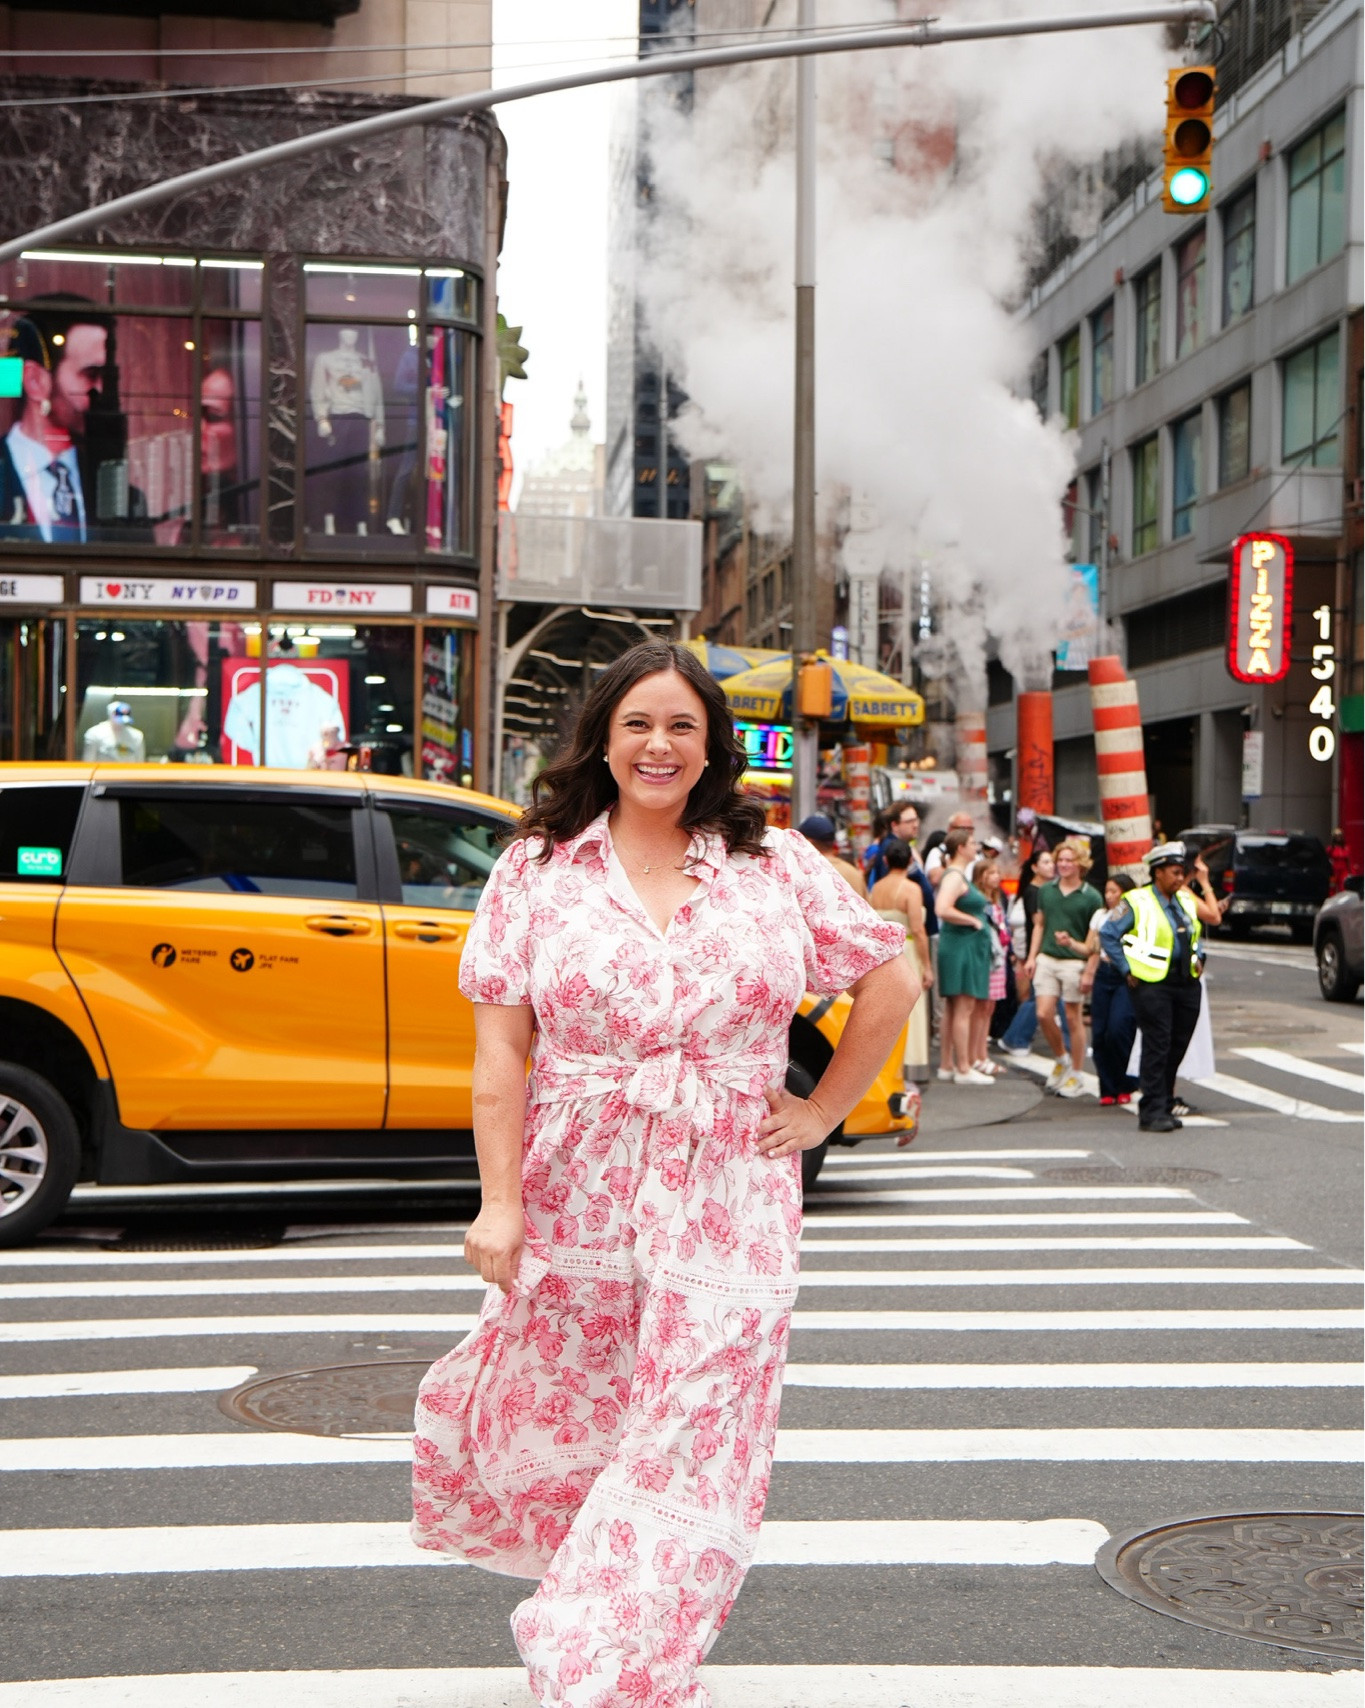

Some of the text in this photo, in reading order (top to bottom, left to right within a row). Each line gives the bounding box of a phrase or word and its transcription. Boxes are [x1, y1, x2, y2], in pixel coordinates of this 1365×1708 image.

[1247, 541, 1276, 675] PIZZA
[1309, 605, 1336, 762] 1540
[726, 696, 777, 714] ABRETT
[853, 701, 918, 717] SABRETT
[21, 851, 59, 865] curb
